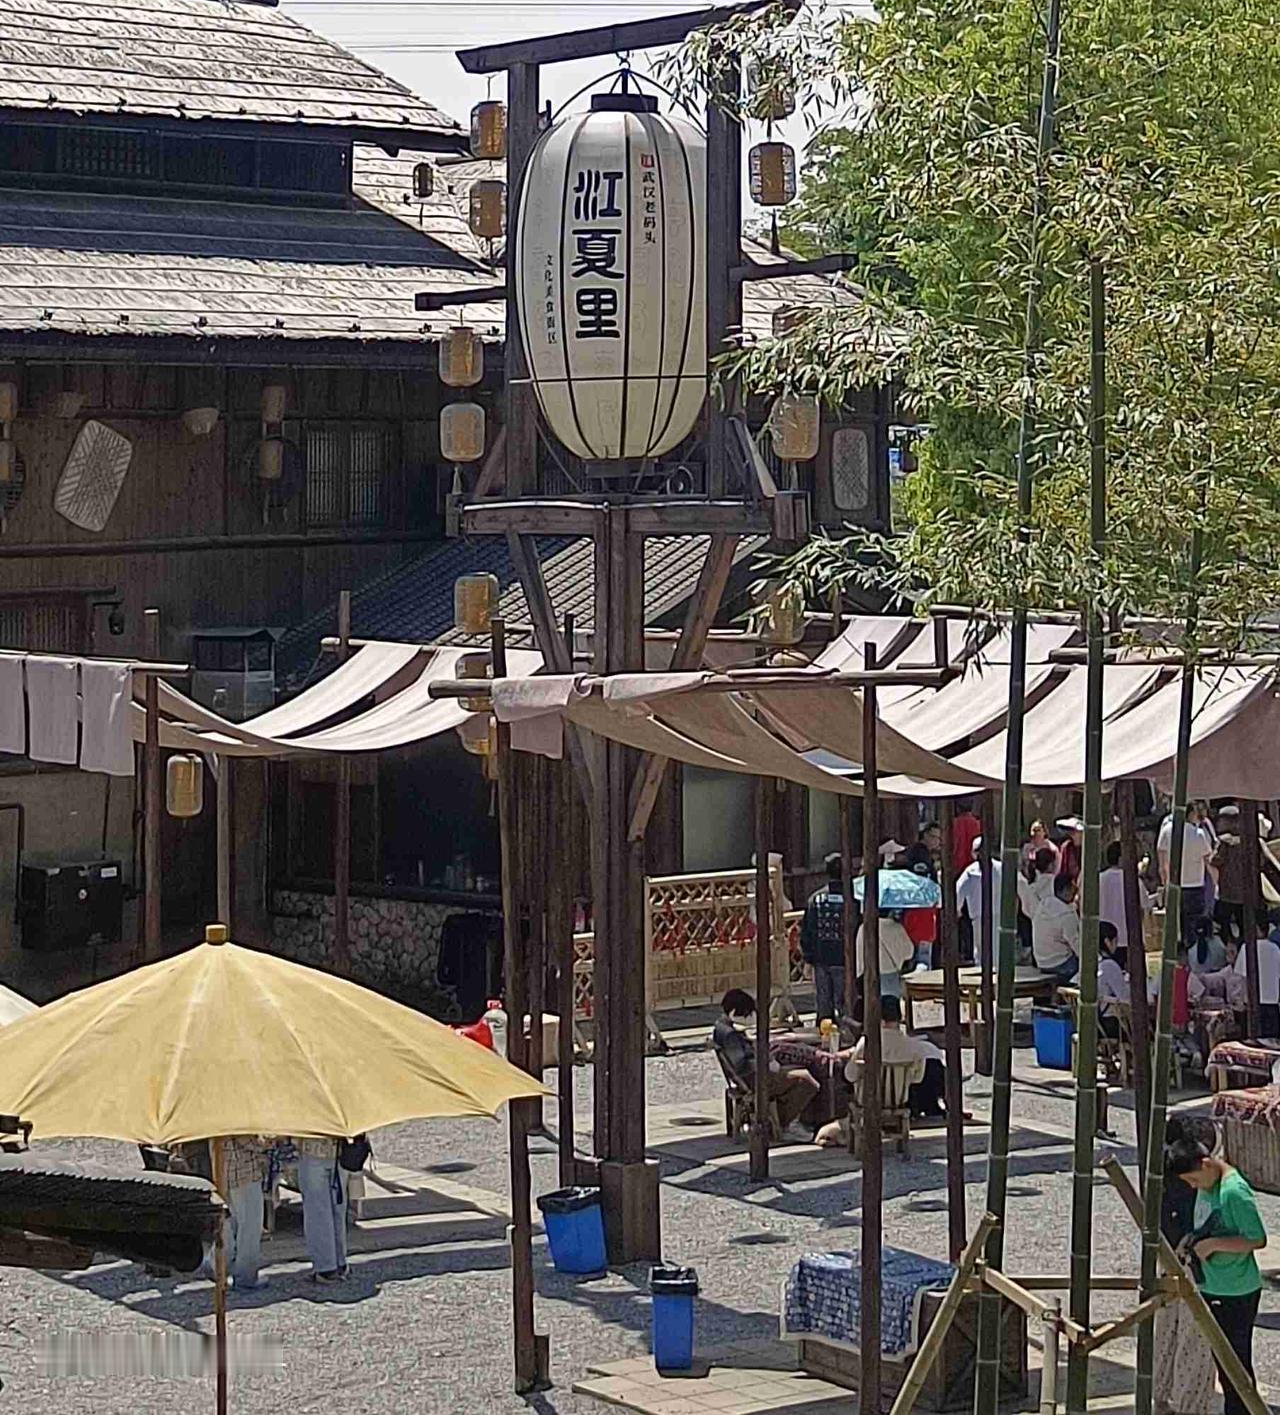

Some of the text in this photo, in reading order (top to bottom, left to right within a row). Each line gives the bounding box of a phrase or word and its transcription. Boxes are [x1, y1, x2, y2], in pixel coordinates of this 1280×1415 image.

[572, 169, 625, 339] 江夏里
[642, 171, 656, 244] 武汉老码头
